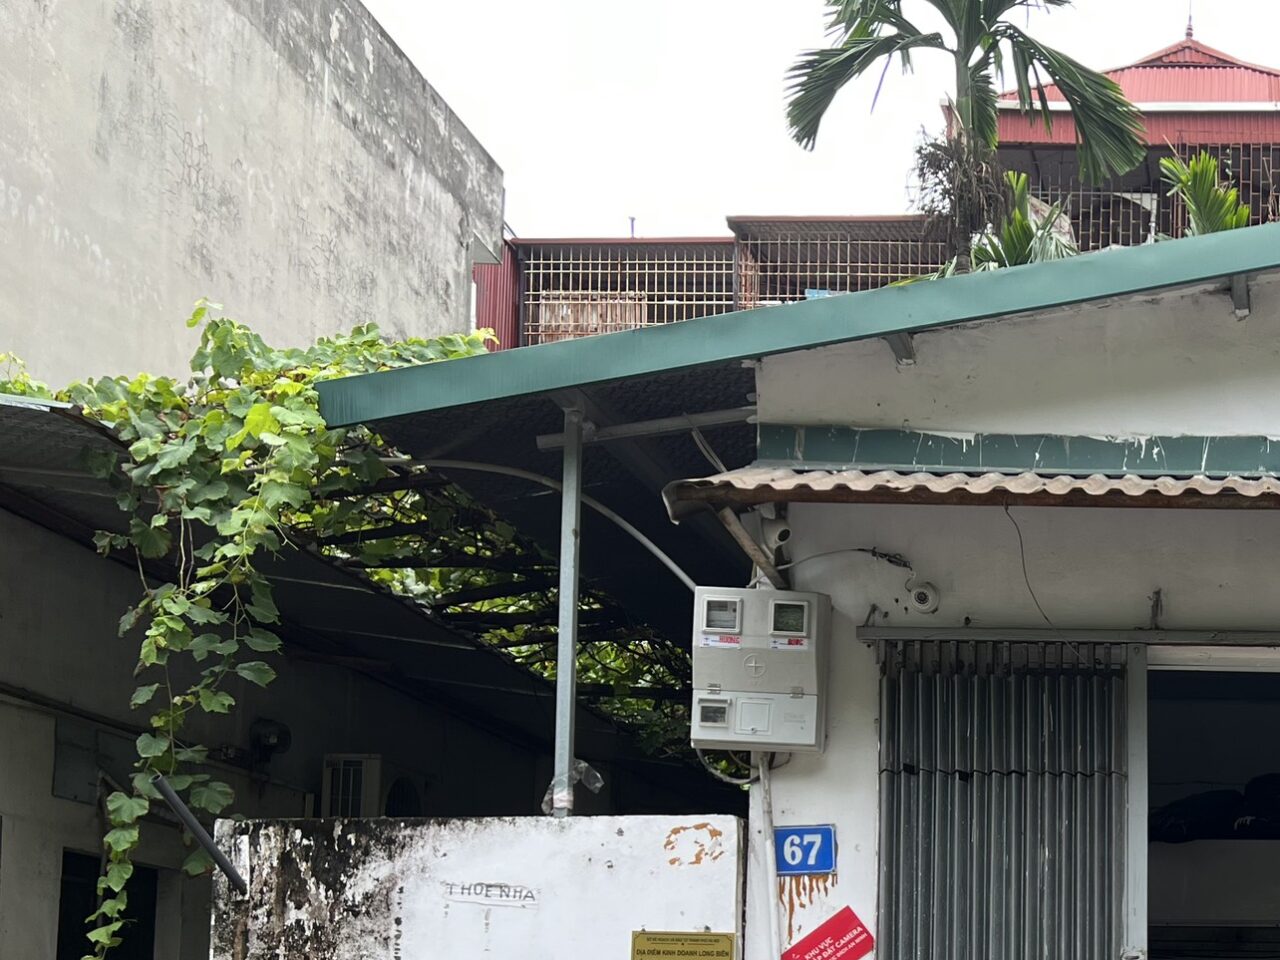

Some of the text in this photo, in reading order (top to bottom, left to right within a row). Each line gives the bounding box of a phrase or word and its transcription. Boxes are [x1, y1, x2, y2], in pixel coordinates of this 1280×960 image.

[783, 834, 822, 866] 67
[835, 926, 863, 948] CAMERA
[804, 947, 820, 960] KHU
